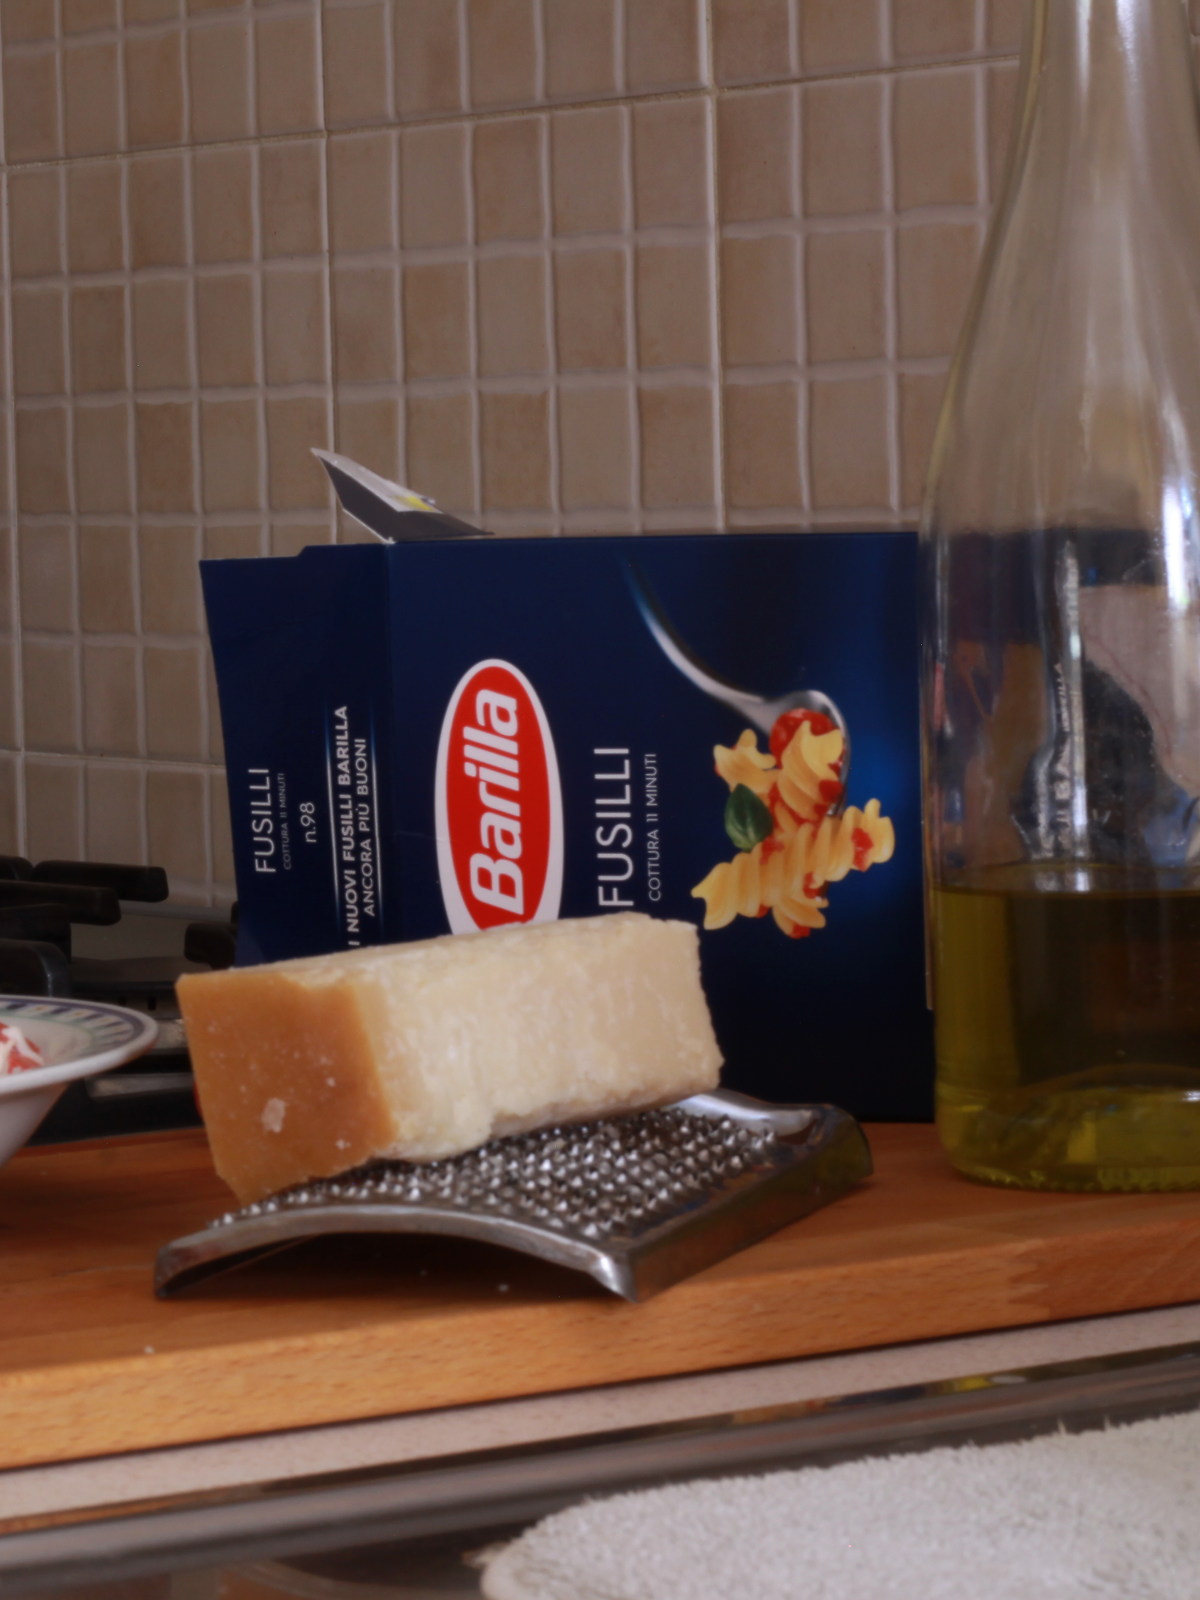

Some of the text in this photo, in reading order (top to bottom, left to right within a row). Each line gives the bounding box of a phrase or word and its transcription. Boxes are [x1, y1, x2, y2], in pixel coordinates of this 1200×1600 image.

[334, 705, 351, 786] BARILLA
[644, 753, 659, 807] MINUTI
[247, 768, 277, 873] FUSILLI
[277, 772, 287, 808] MINUTI
[300, 802, 318, 843] n.98
[462, 688, 525, 916] Barilla
[281, 822, 292, 871] COTTURA
[338, 794, 356, 861] FUSILLI
[354, 738, 376, 917] ANCORA PIÙ BUONI
[593, 748, 635, 907] FUSILLI
[343, 869, 360, 932] NUOVI
[647, 829, 662, 902] COTTURA
